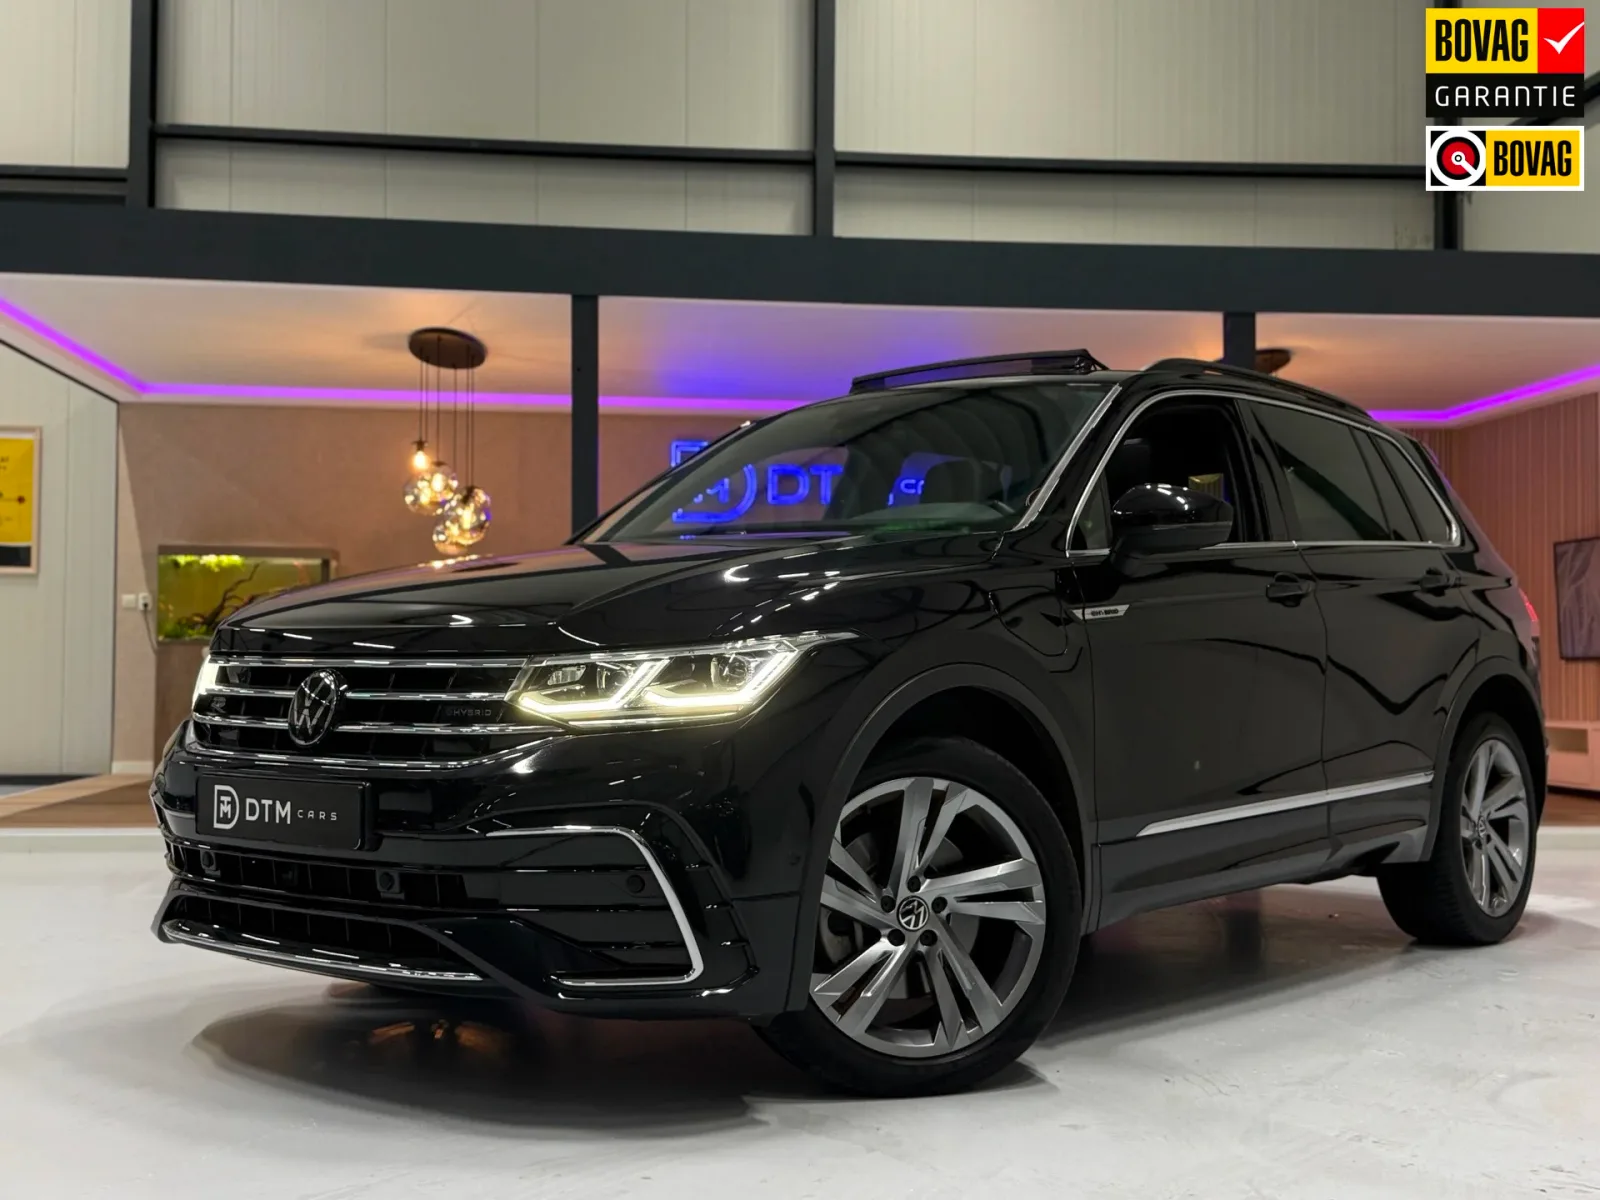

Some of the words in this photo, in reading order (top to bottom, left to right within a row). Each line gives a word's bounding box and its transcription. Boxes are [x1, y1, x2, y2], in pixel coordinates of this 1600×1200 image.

[766, 463, 843, 505] DT
[245, 797, 291, 825] DTM
[297, 809, 338, 821] CARS
